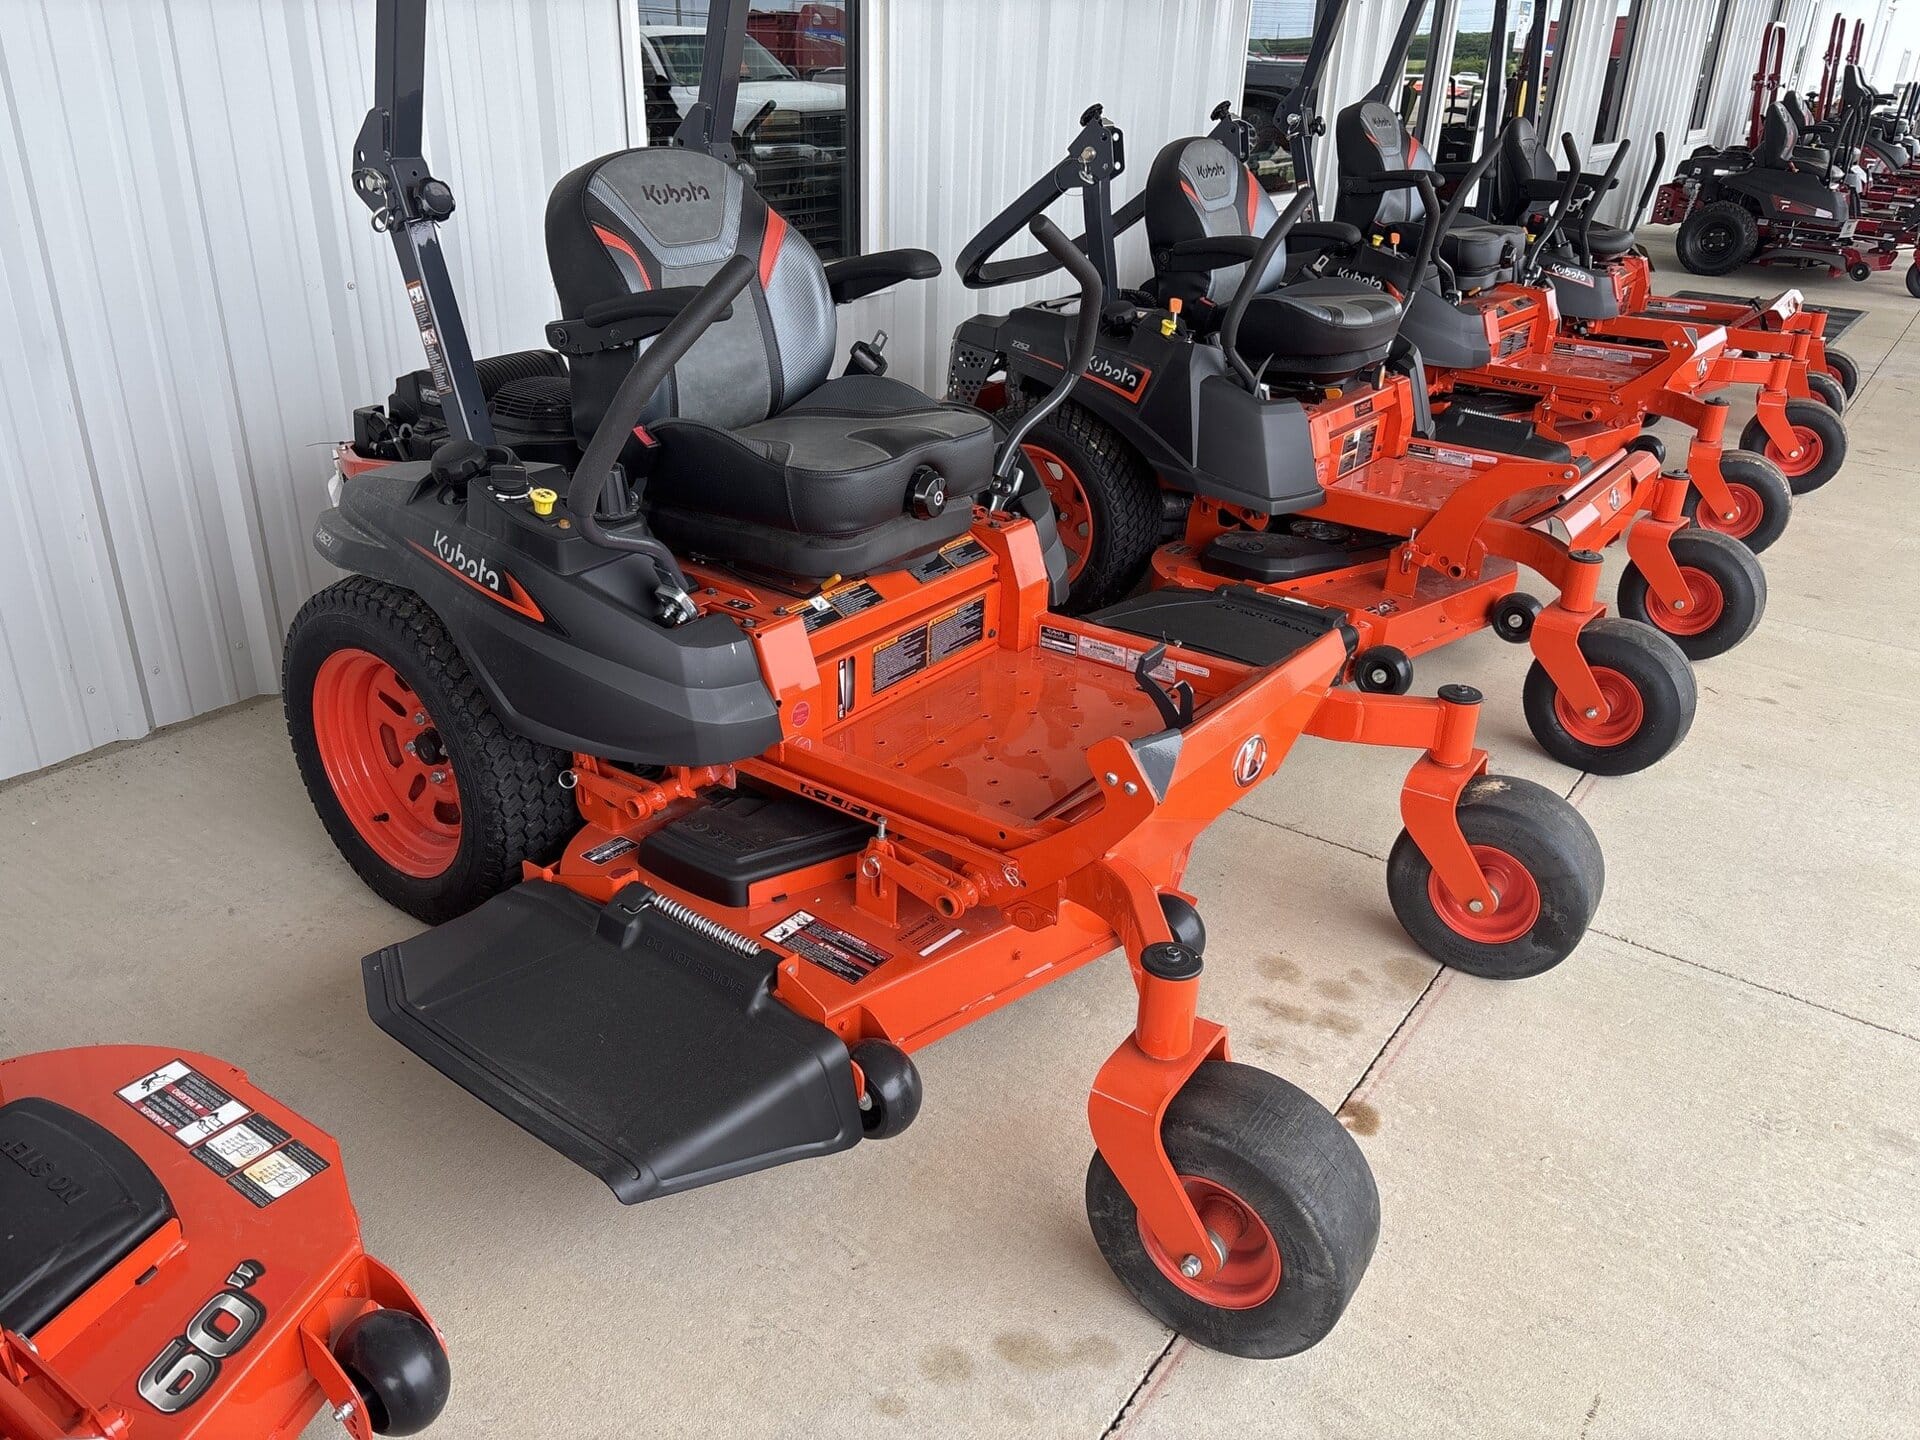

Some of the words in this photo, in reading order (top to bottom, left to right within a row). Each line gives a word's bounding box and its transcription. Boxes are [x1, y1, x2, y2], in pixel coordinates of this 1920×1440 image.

[641, 181, 710, 205] Kubota
[1552, 263, 1586, 281] Kubota
[433, 529, 499, 591] Kubota
[842, 933, 868, 946] DANGER
[823, 945, 850, 959] PELIGRO
[170, 1087, 199, 1107] PELIGRO
[139, 1105, 166, 1124] DANGER
